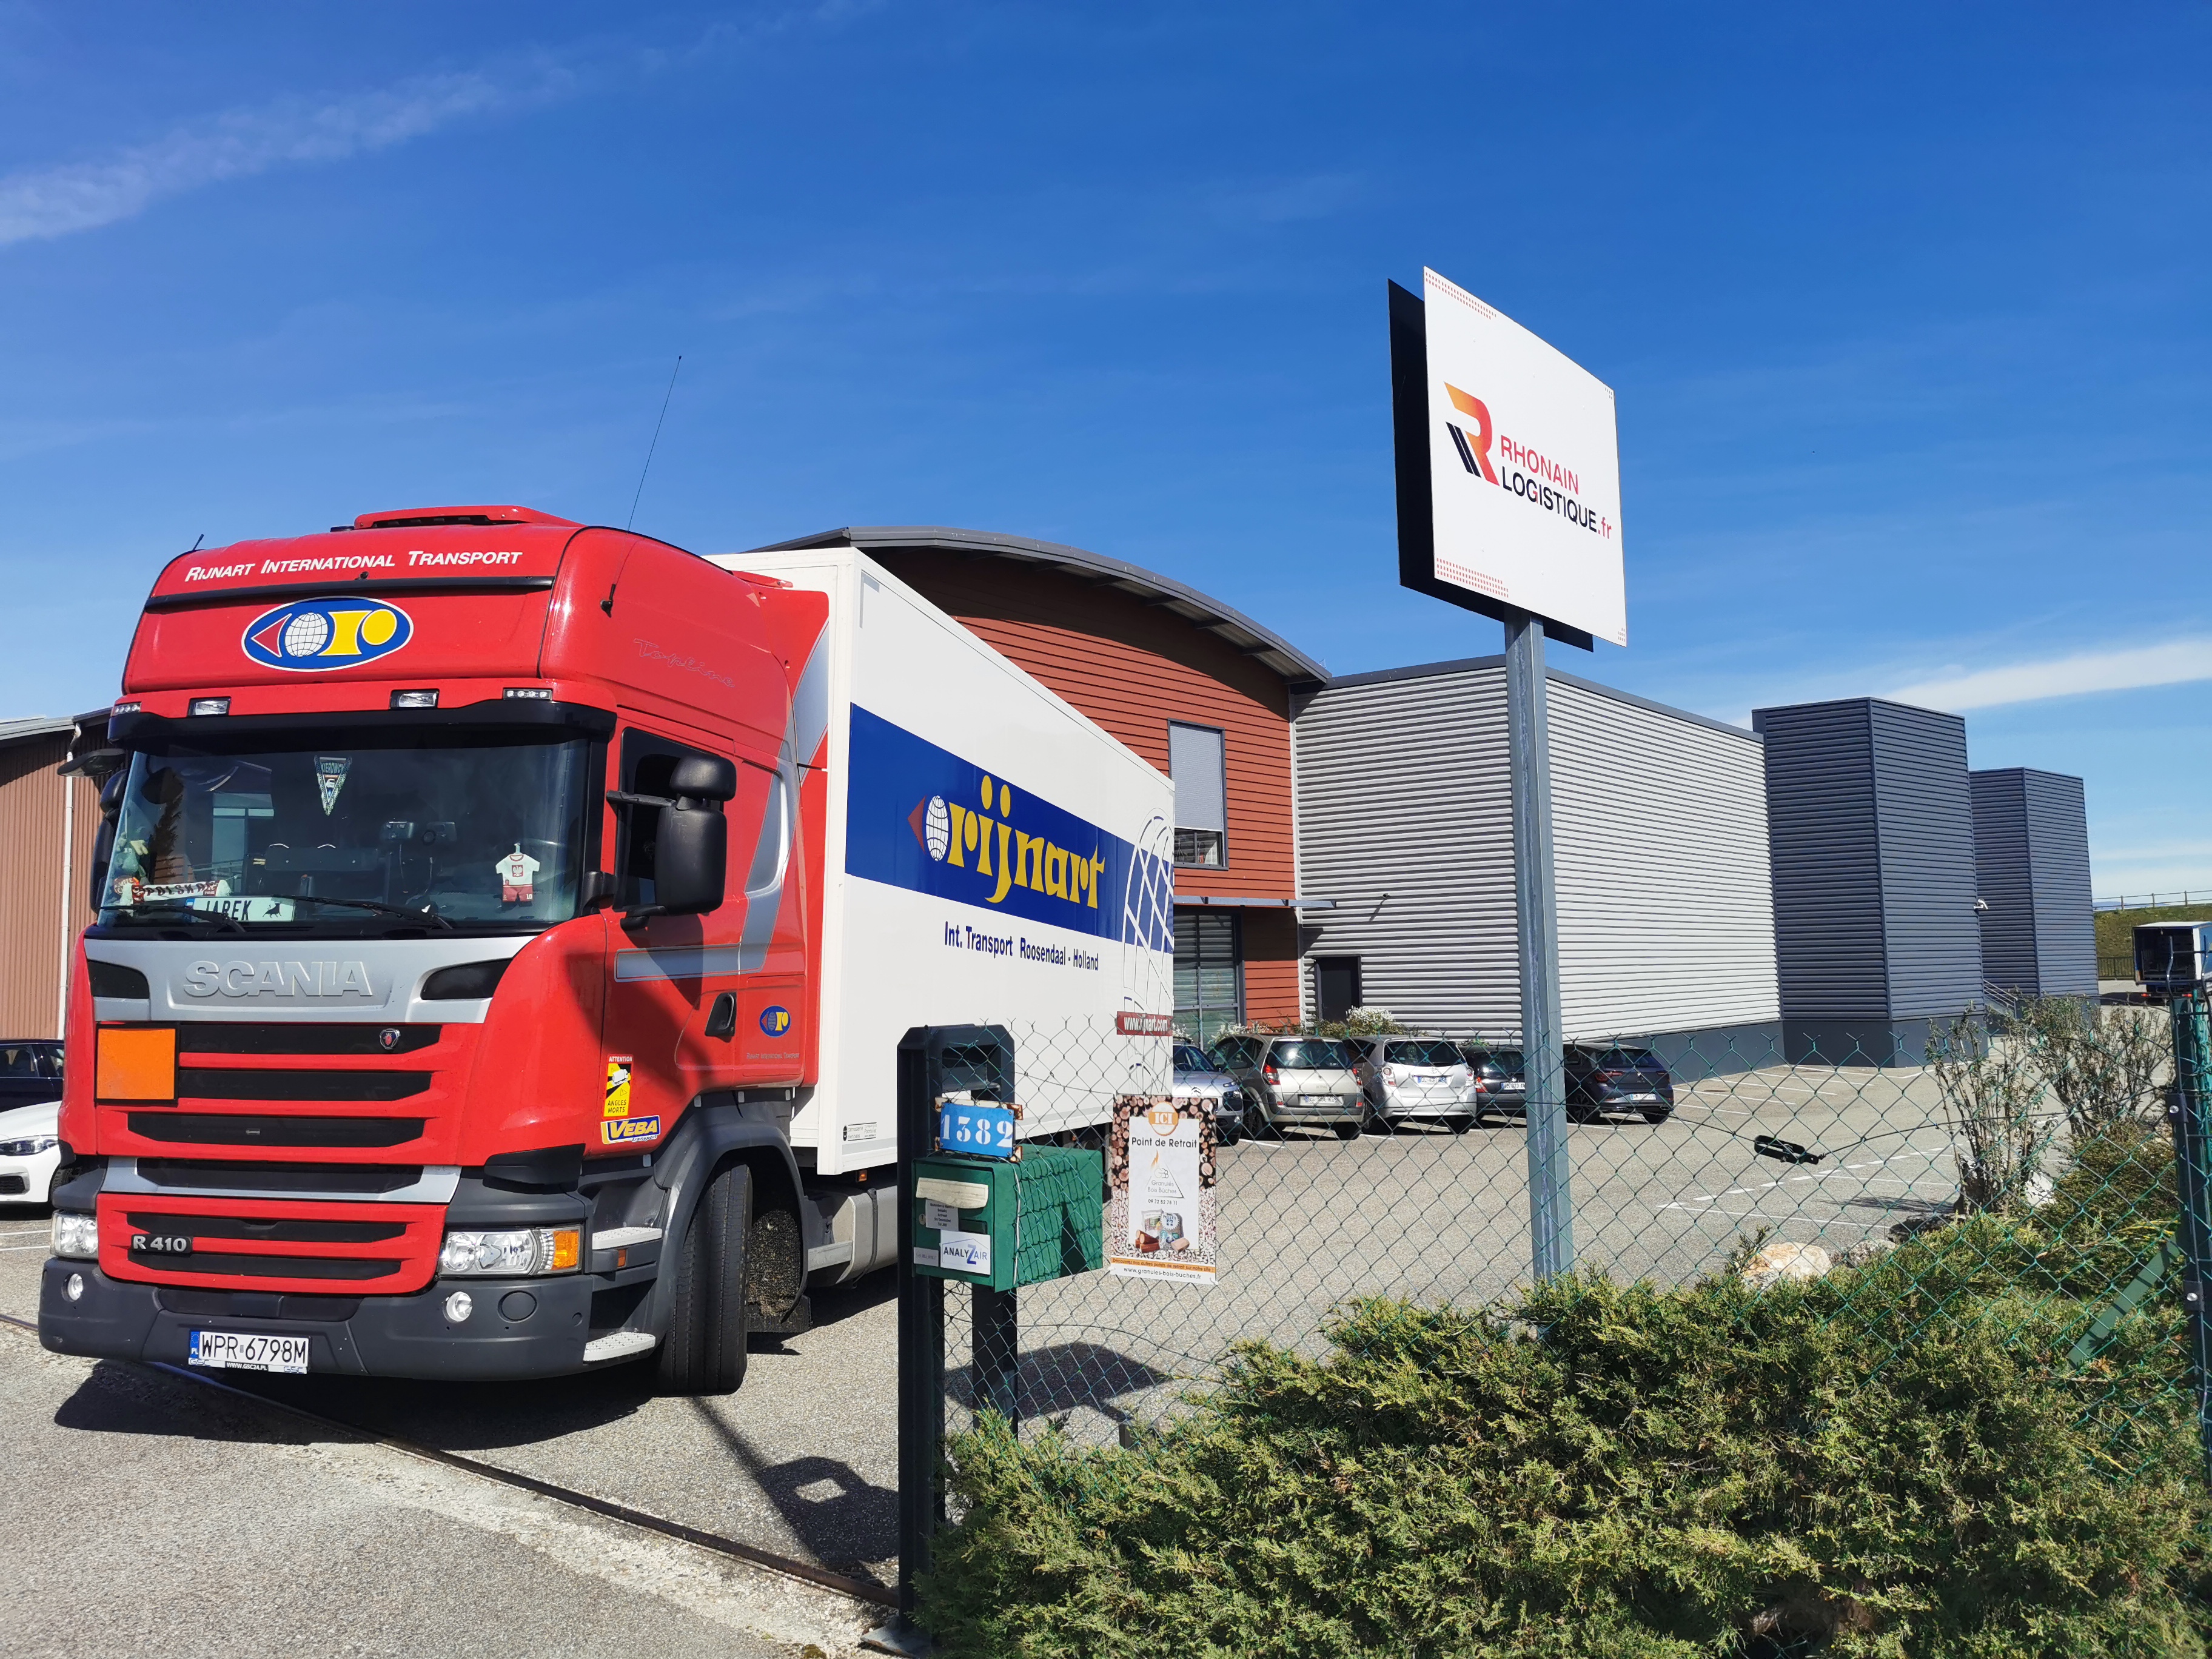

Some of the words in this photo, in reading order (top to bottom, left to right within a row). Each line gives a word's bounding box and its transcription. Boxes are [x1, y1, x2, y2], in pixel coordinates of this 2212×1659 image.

[1501, 434, 1578, 495] RHONAIN
[1503, 466, 1612, 539] LOGISTIQUE.fr
[185, 563, 255, 582] RIJNART
[260, 553, 395, 575] INTERNATIONAL
[407, 550, 522, 567] TRANSPORT
[634, 638, 735, 688] Topline
[947, 774, 1105, 909] rijnart
[944, 921, 963, 948] Int.
[965, 926, 1013, 959] Transport
[1019, 937, 1066, 966] Roosendaal
[1073, 948, 1099, 971] Holland
[183, 960, 372, 997] SCANIA
[1124, 1014, 1168, 1034] www.rijnart.com
[610, 1120, 657, 1138] VEBA
[940, 1114, 1013, 1148] 1382
[1155, 1113, 1173, 1124] ICI
[1132, 1137, 1152, 1146] Point
[1155, 1138, 1166, 1147] de
[1169, 1139, 1197, 1148] Retrait
[133, 1236, 146, 1250] R
[151, 1237, 187, 1252] 410
[943, 1244, 988, 1265] ANALYZAIR
[1124, 1267, 1201, 1279] www.granules-bois-buches.fr
[203, 1335, 238, 1359] WPR
[246, 1338, 306, 1364] 6798M
[227, 1362, 268, 1371] WWW.GSC24.PL
